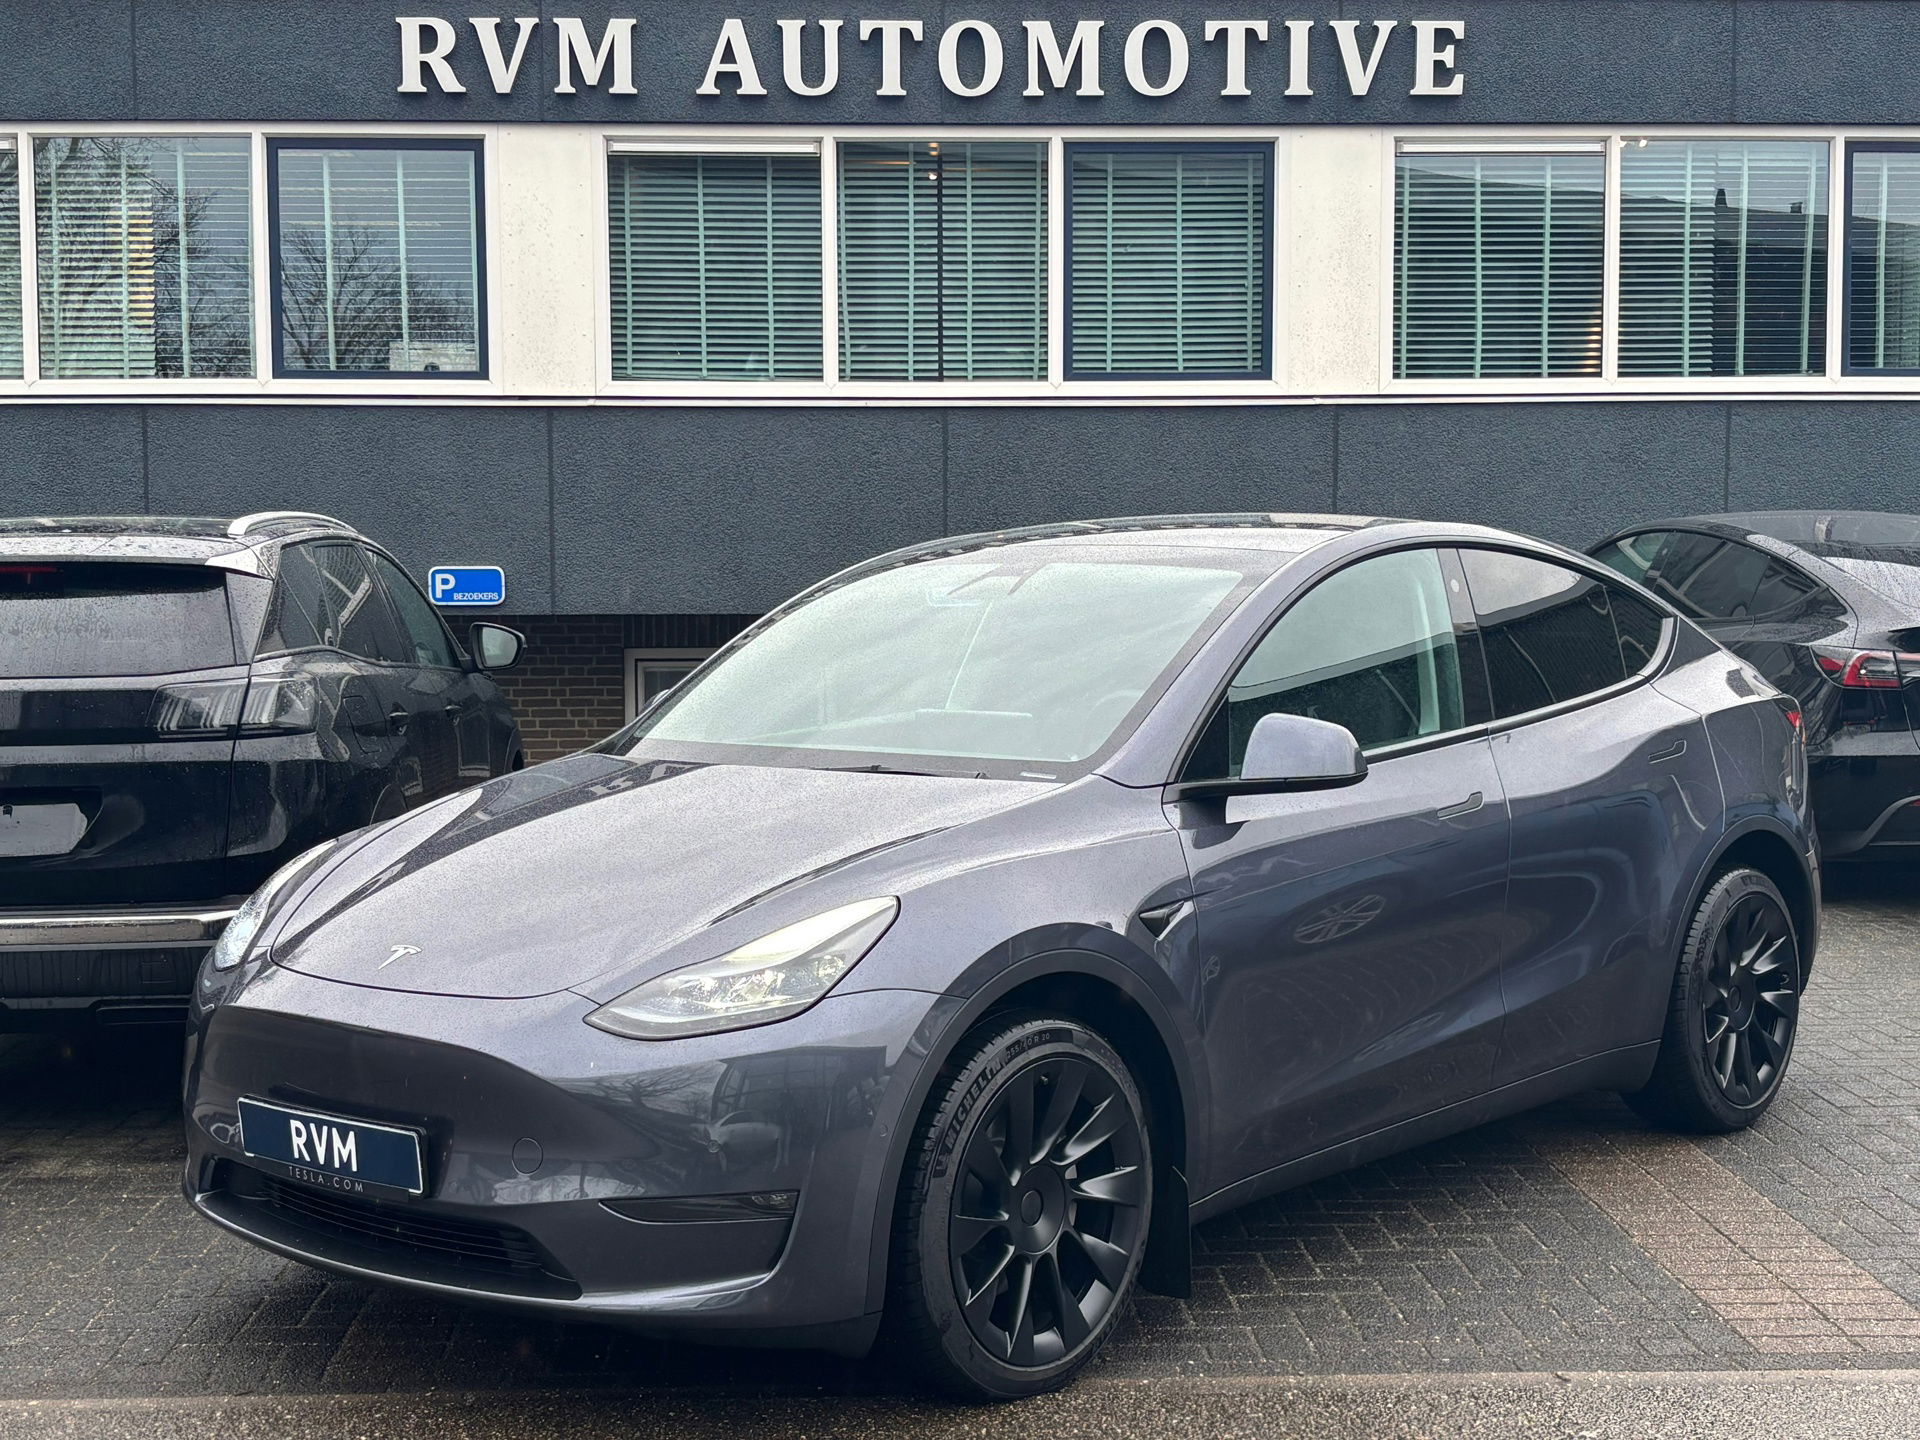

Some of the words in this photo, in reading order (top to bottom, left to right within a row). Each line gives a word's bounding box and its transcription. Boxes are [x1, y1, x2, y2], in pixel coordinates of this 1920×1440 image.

[395, 16, 638, 94] RVM
[695, 18, 1466, 97] AUTOMOTIVE
[435, 573, 456, 598] P
[453, 592, 499, 601] BEZOEKERS
[944, 1060, 1003, 1150] MICHELIN
[289, 1119, 358, 1172] RVM
[288, 1166, 364, 1193] TESLA.COM
